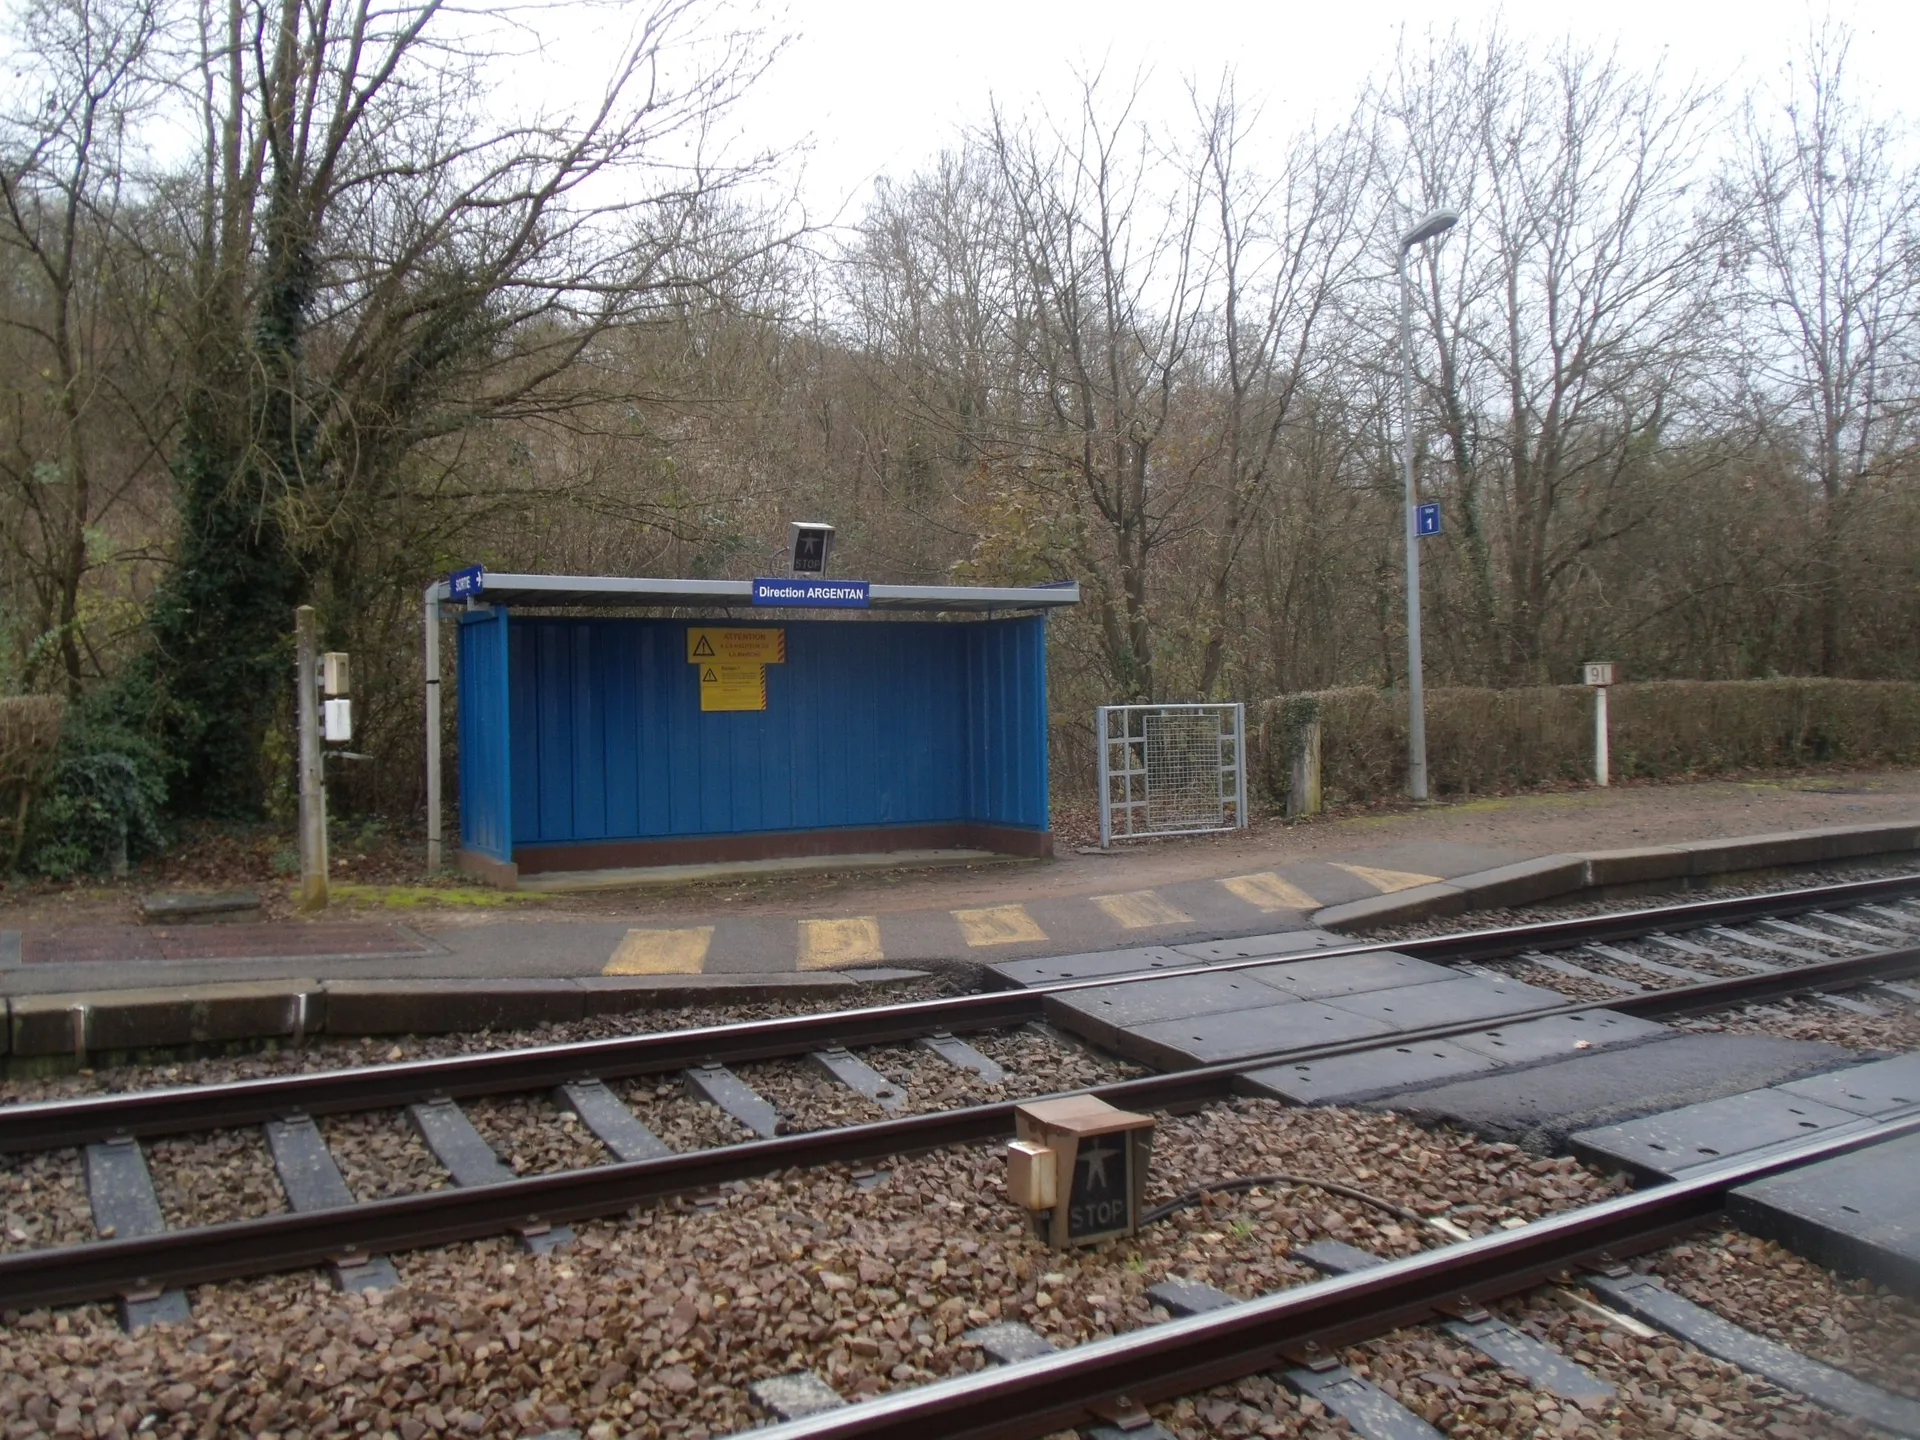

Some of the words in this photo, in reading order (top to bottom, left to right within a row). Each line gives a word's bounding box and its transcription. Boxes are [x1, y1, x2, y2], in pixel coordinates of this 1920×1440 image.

[1426, 517, 1432, 530] 1
[795, 559, 821, 569] STOP
[759, 586, 805, 598] Direction
[807, 587, 864, 599] ARGENTAN
[723, 632, 766, 641] ATTENTION
[1591, 666, 1605, 682] 91
[1071, 1200, 1123, 1229] STOP
